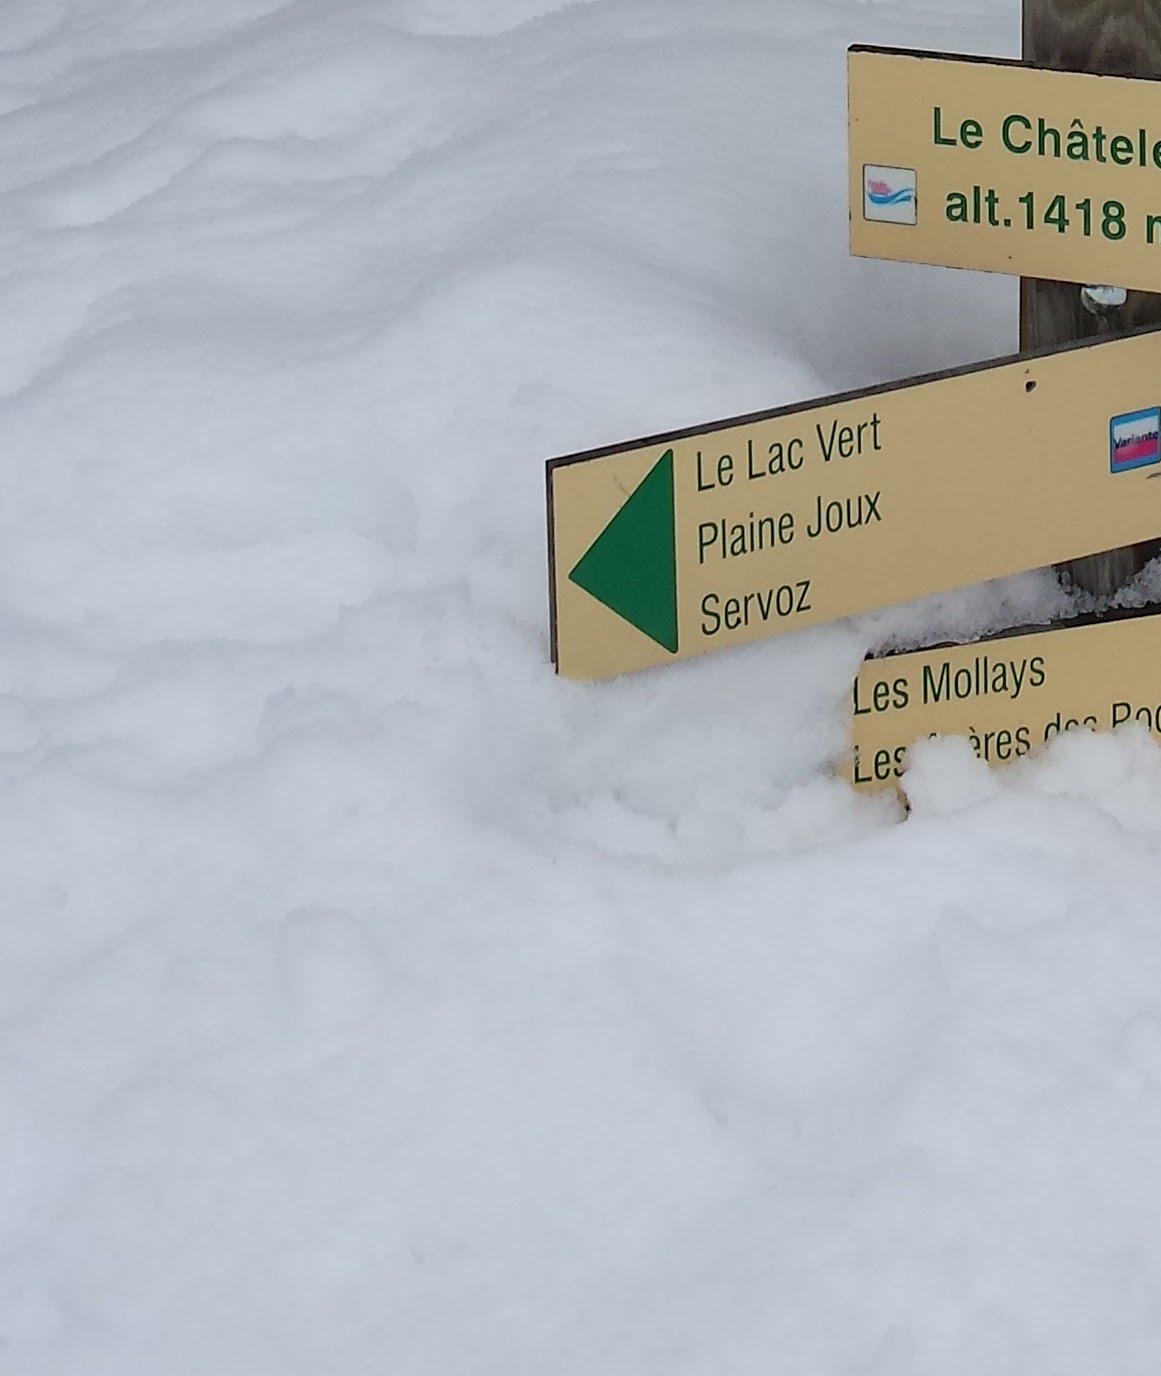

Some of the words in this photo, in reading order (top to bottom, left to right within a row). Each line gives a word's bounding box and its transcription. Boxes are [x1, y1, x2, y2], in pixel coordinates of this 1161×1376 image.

[933, 107, 984, 149] Le
[696, 451, 734, 492] Le
[748, 438, 804, 480] Lac
[816, 413, 882, 462] Vert
[1114, 429, 1160, 450] Variante
[698, 511, 795, 565] Plaine
[806, 491, 882, 538] Joux
[701, 580, 812, 636] Servoz
[853, 675, 909, 715] Les
[922, 655, 1046, 706] Mollays
[854, 744, 906, 784] Les
